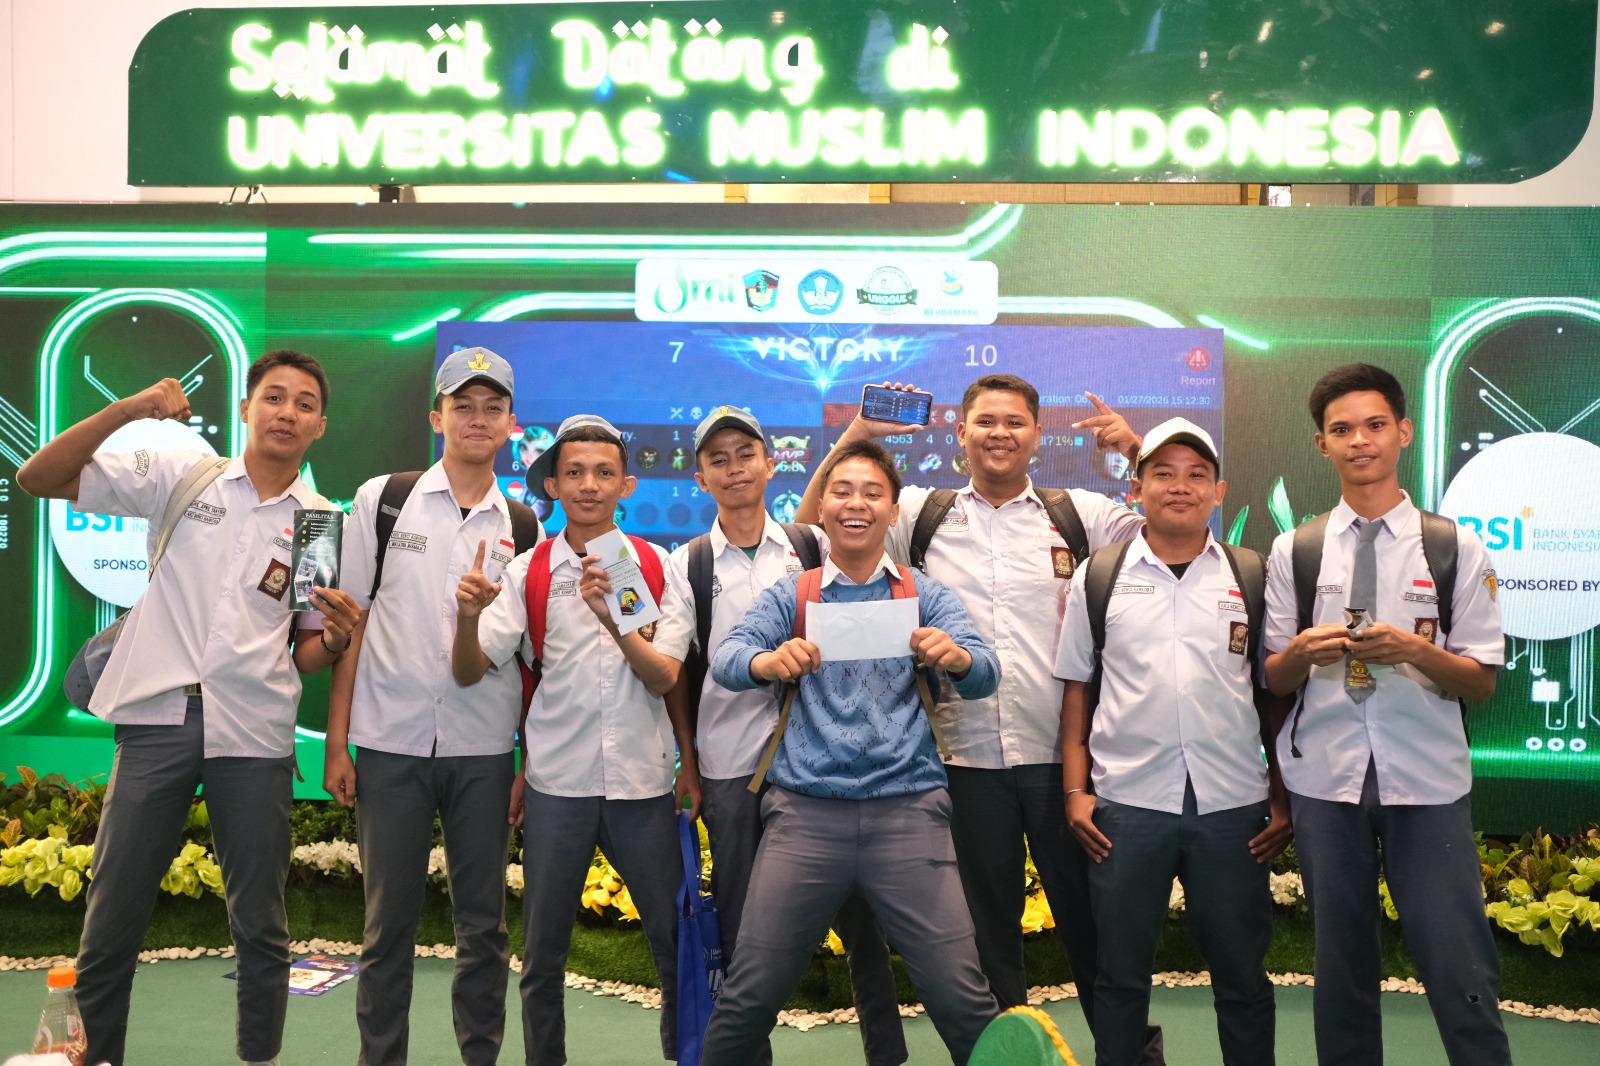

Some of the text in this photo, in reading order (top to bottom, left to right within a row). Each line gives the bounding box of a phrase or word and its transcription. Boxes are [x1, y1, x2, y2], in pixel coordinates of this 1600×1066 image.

[226, 107, 1460, 169] UNIVERSITAS MUSLIM INDONESIA
[923, 308, 979, 317] BERDAMPAK
[668, 341, 685, 363] 7
[752, 336, 904, 362] VICTORY
[964, 344, 998, 367] 10
[1180, 375, 1216, 387] Report
[1118, 395, 1169, 405] 01/27/2026
[884, 434, 954, 444] 4563 4 0
[773, 450, 805, 459] MVP
[691, 486, 699, 497] 2
[1533, 528, 1570, 539] BANK
[93, 558, 148, 571] SPONSO
[1496, 578, 1600, 591] PONSORED BY
